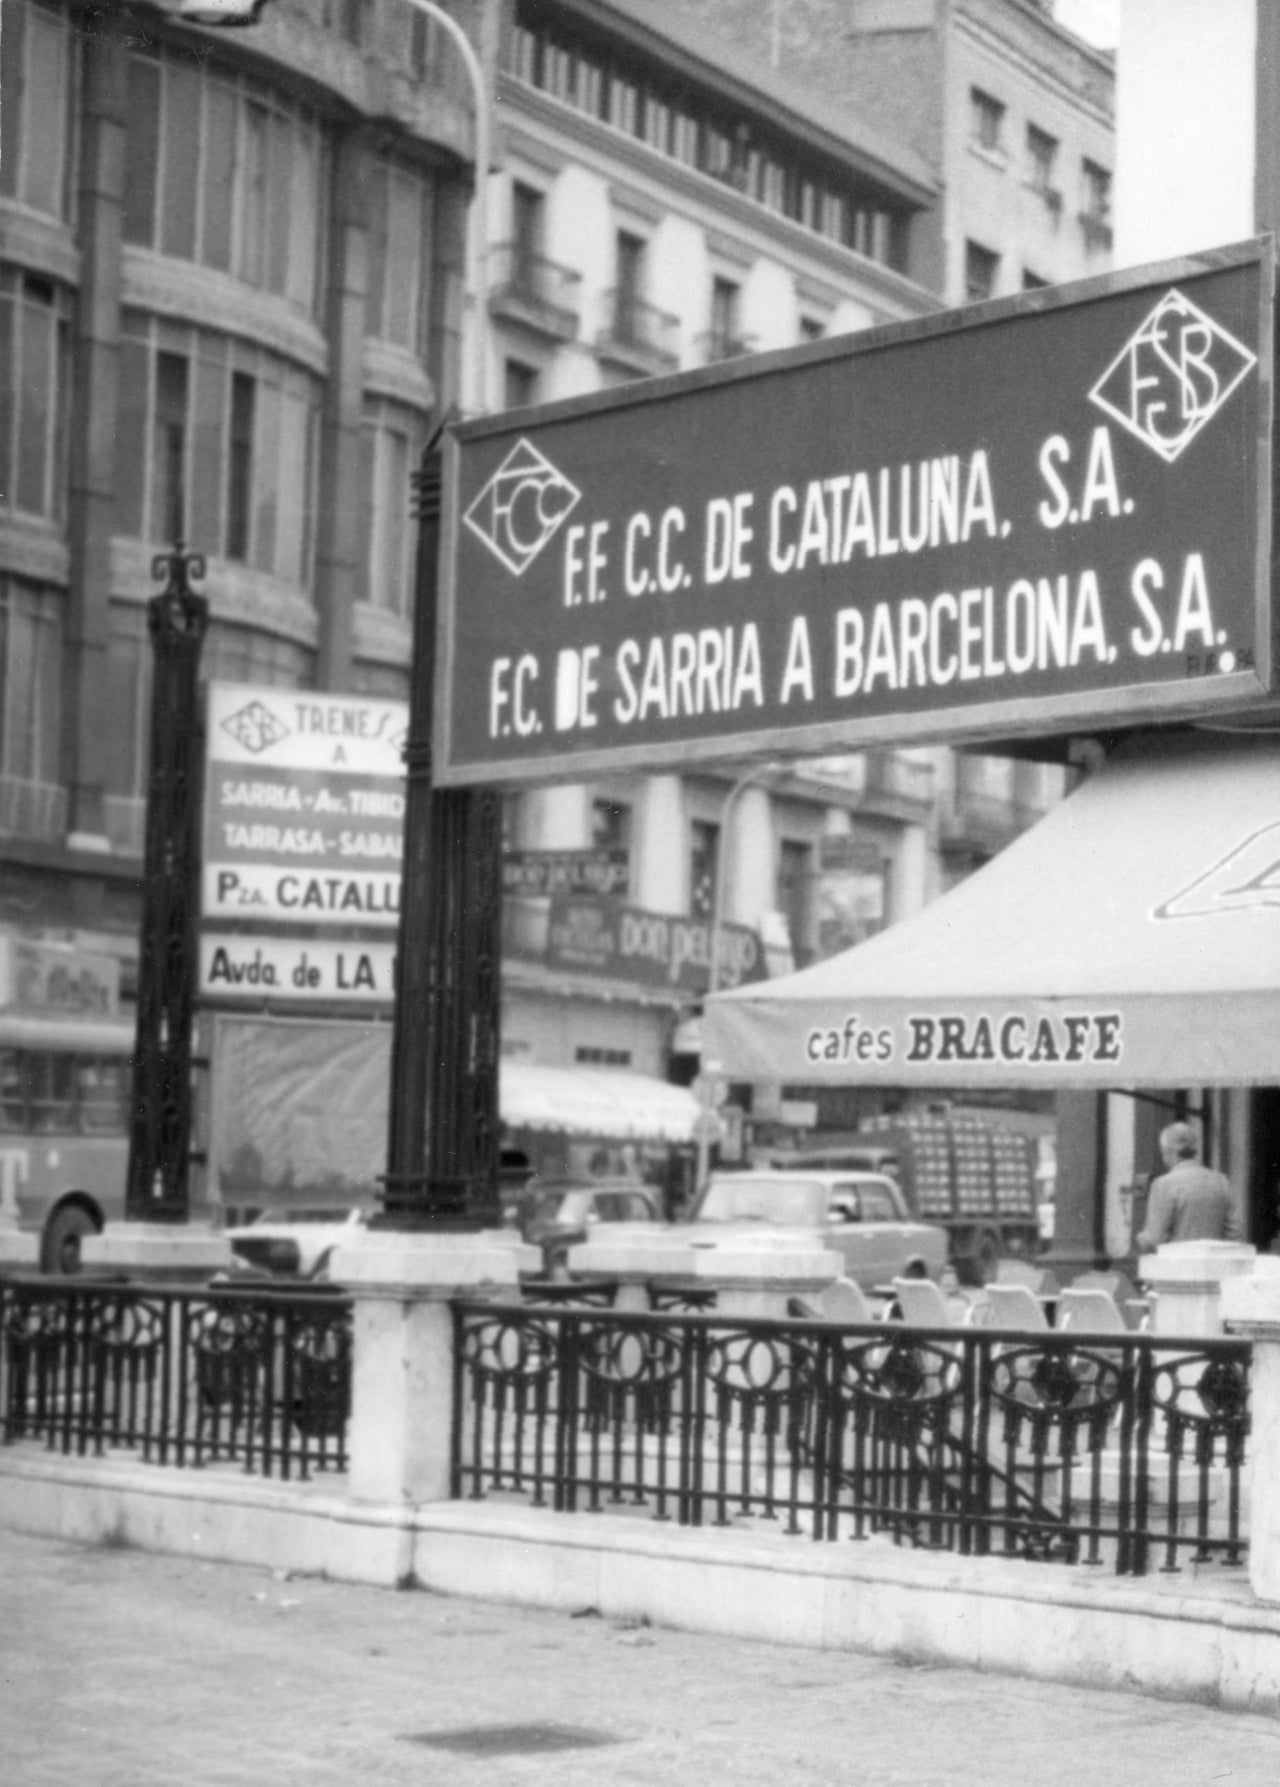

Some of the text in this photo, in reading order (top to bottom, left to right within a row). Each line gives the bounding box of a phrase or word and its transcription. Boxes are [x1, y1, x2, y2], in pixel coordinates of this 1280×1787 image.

[624, 506, 691, 597] C.C.
[705, 491, 754, 584] DE
[1038, 425, 1135, 529] S.A.
[555, 645, 600, 731] DE
[614, 622, 763, 724] SARRIA
[779, 614, 815, 704] A
[1131, 553, 1227, 656] S.A.
[292, 953, 322, 988] de
[336, 954, 376, 990] LA
[807, 1015, 1120, 1061] cafes BRACAFE
